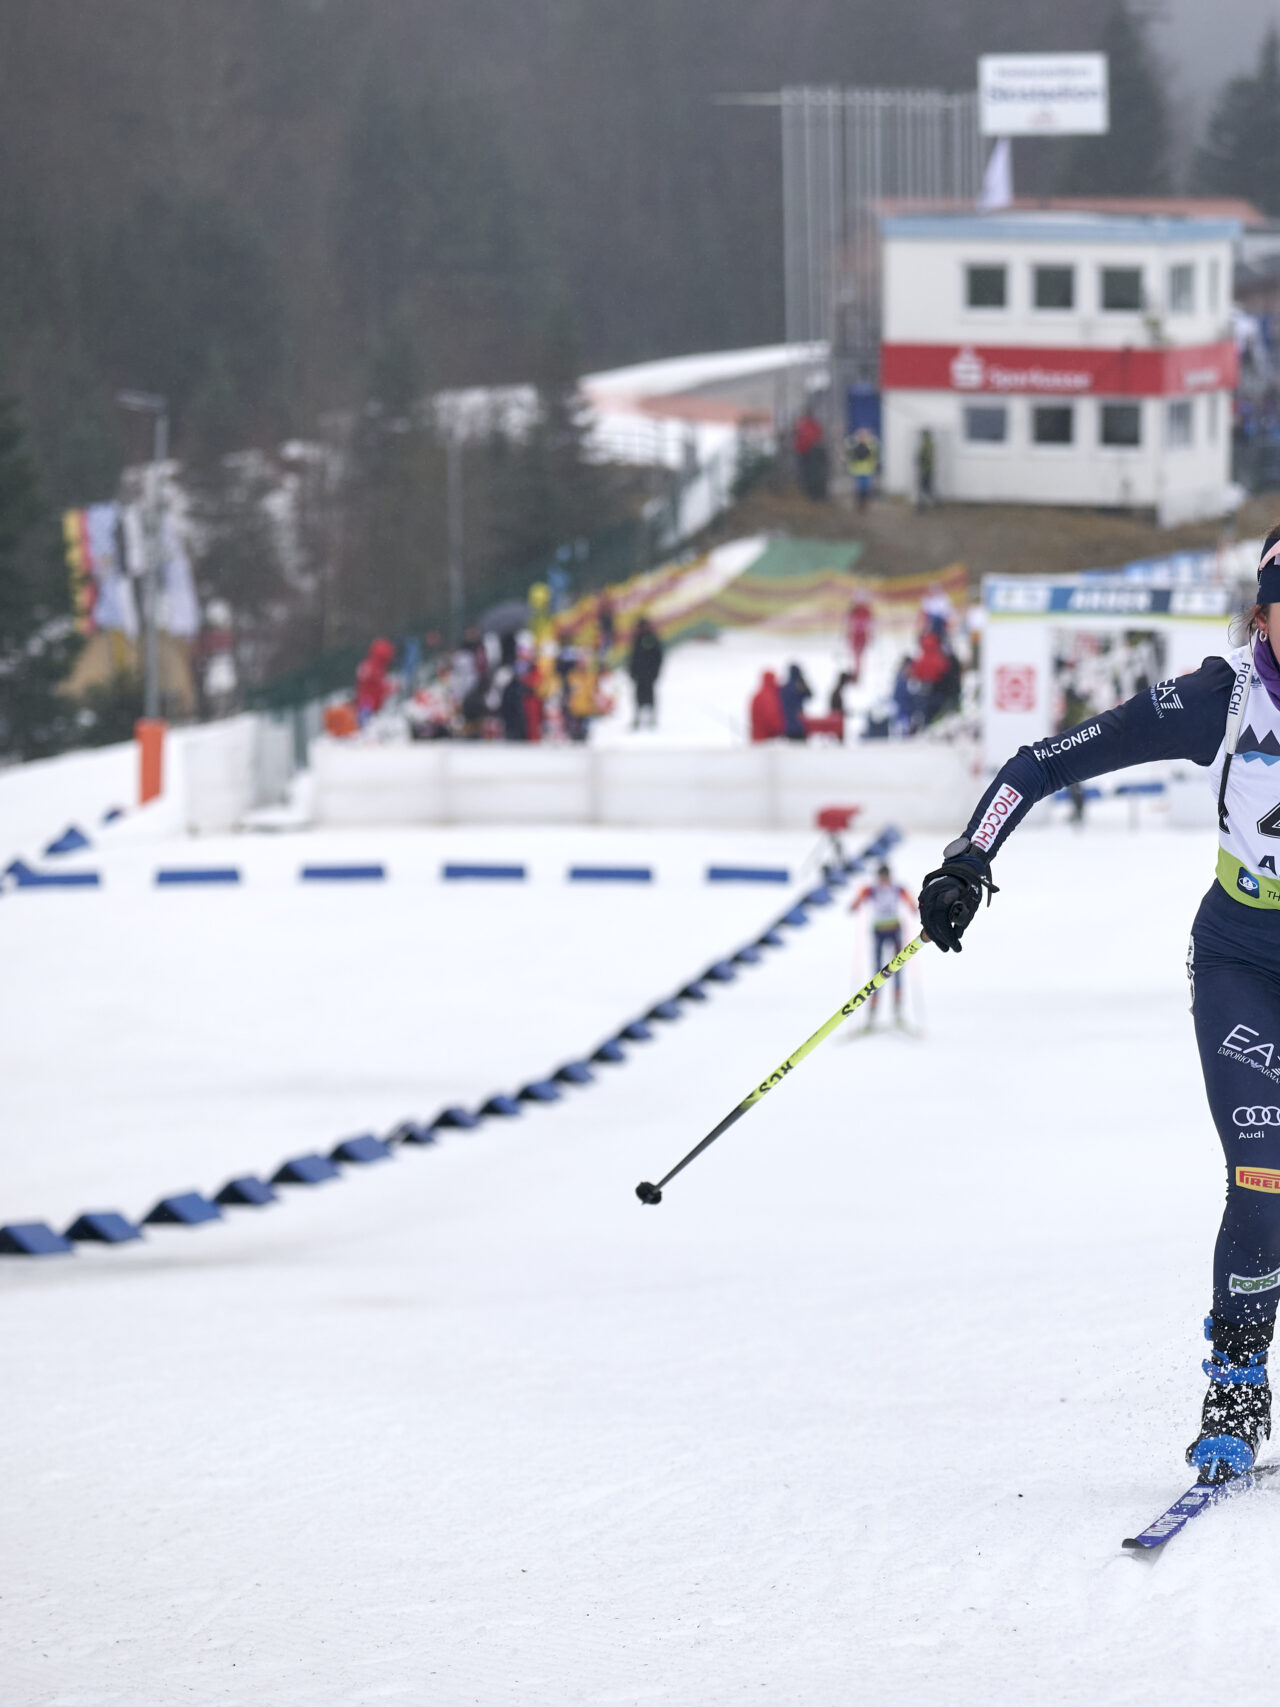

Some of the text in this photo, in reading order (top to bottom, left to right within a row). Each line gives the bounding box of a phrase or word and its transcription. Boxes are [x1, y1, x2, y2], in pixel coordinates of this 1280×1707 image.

[1229, 662, 1250, 716] FIOCCHI
[1033, 723, 1102, 761] FALCONERI
[974, 785, 1019, 850] FIOCCHI
[1217, 1046, 1250, 1064] EMPORIO
[1238, 1130, 1265, 1140] Audi
[1230, 1270, 1280, 1292] FORST
